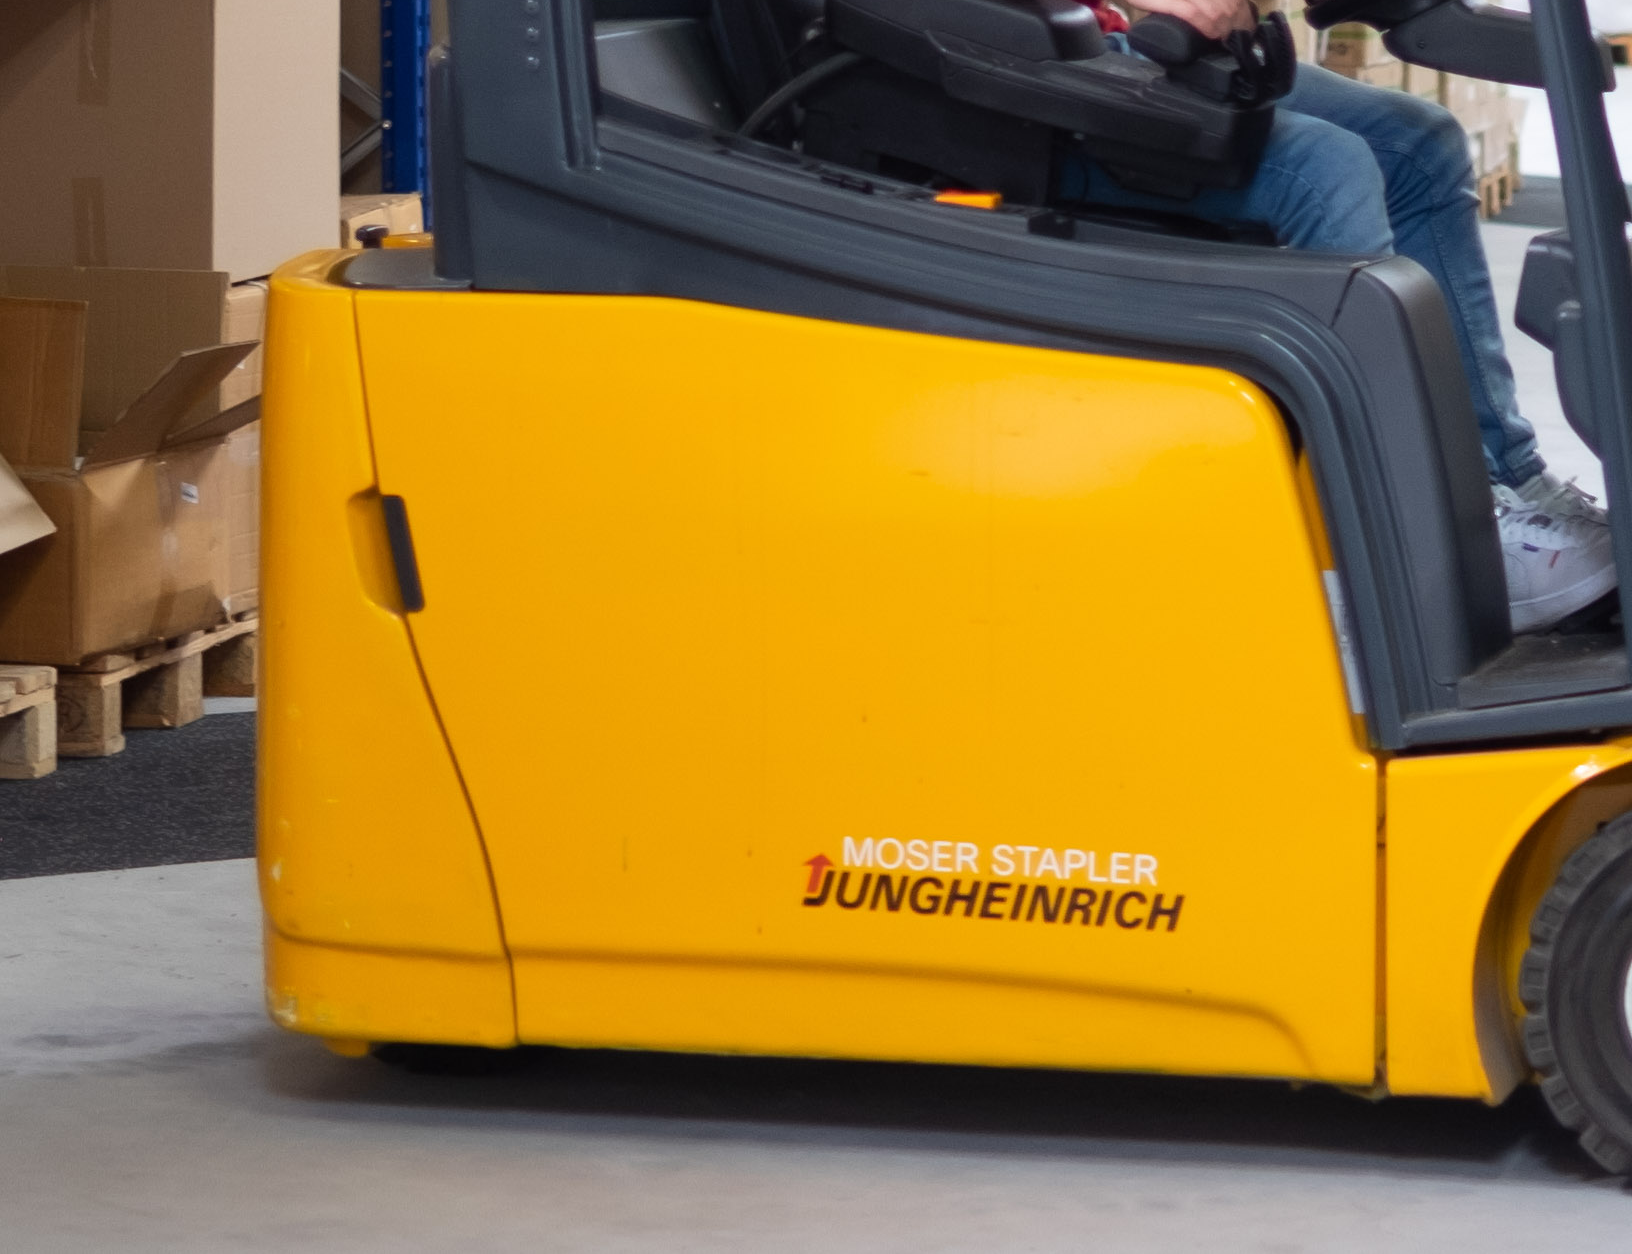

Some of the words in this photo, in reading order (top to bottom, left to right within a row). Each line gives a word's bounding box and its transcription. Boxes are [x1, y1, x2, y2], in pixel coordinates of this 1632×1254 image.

[841, 835, 980, 874] MOSER
[989, 843, 1159, 887] STAPLER
[801, 869, 1186, 933] JUNGHEINRICH
